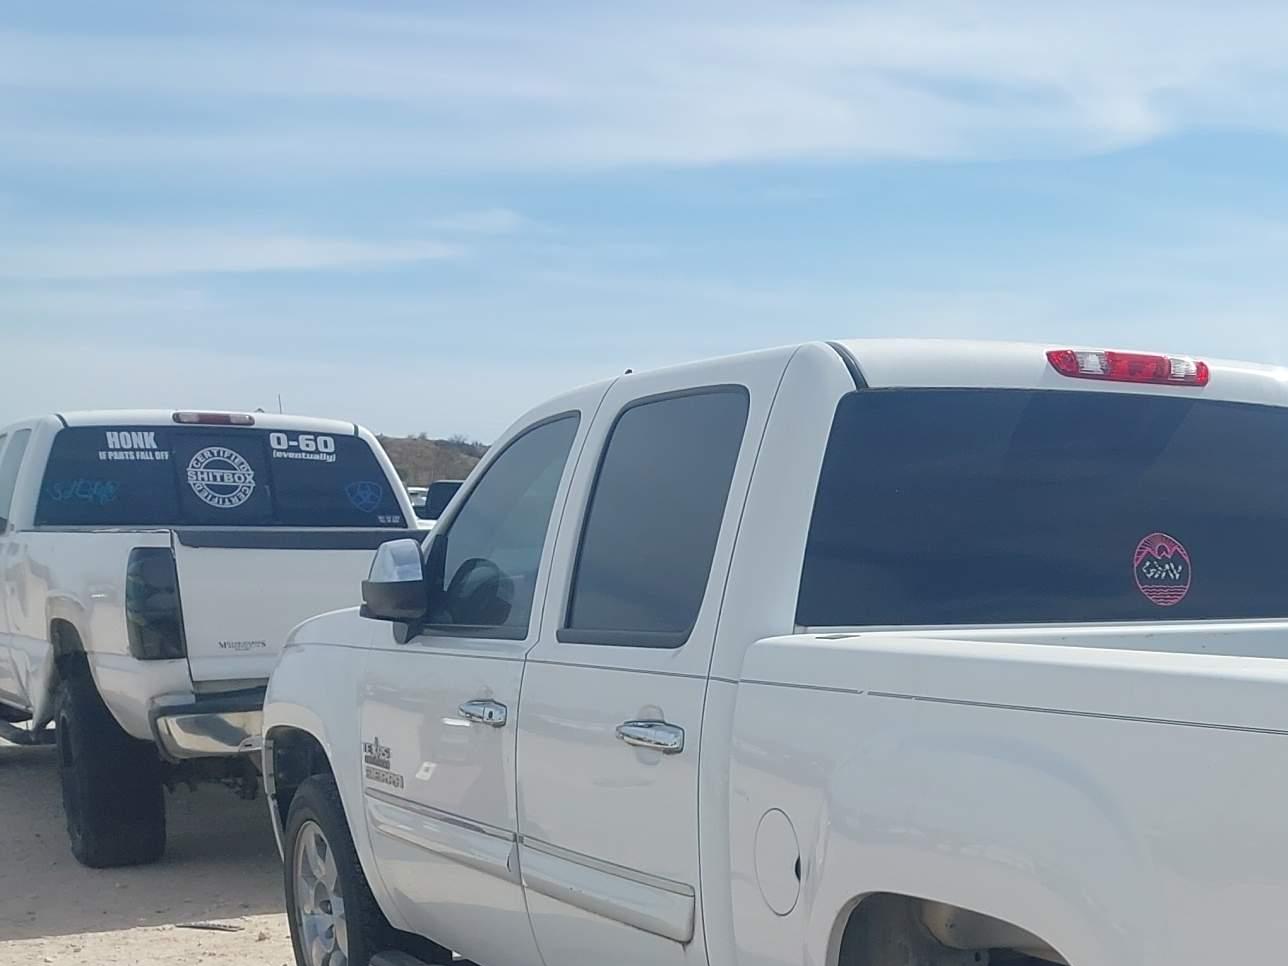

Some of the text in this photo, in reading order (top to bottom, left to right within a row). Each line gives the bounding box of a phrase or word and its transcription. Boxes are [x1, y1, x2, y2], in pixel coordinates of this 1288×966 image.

[106, 431, 157, 449] HONK
[269, 432, 335, 453] 0-60
[108, 451, 135, 460] PARTS
[136, 451, 154, 460] FALL
[155, 451, 169, 460] OFF
[192, 449, 249, 471] CERTIFIED
[188, 470, 254, 485] SHITBOX
[195, 483, 249, 506] CERTIFIED
